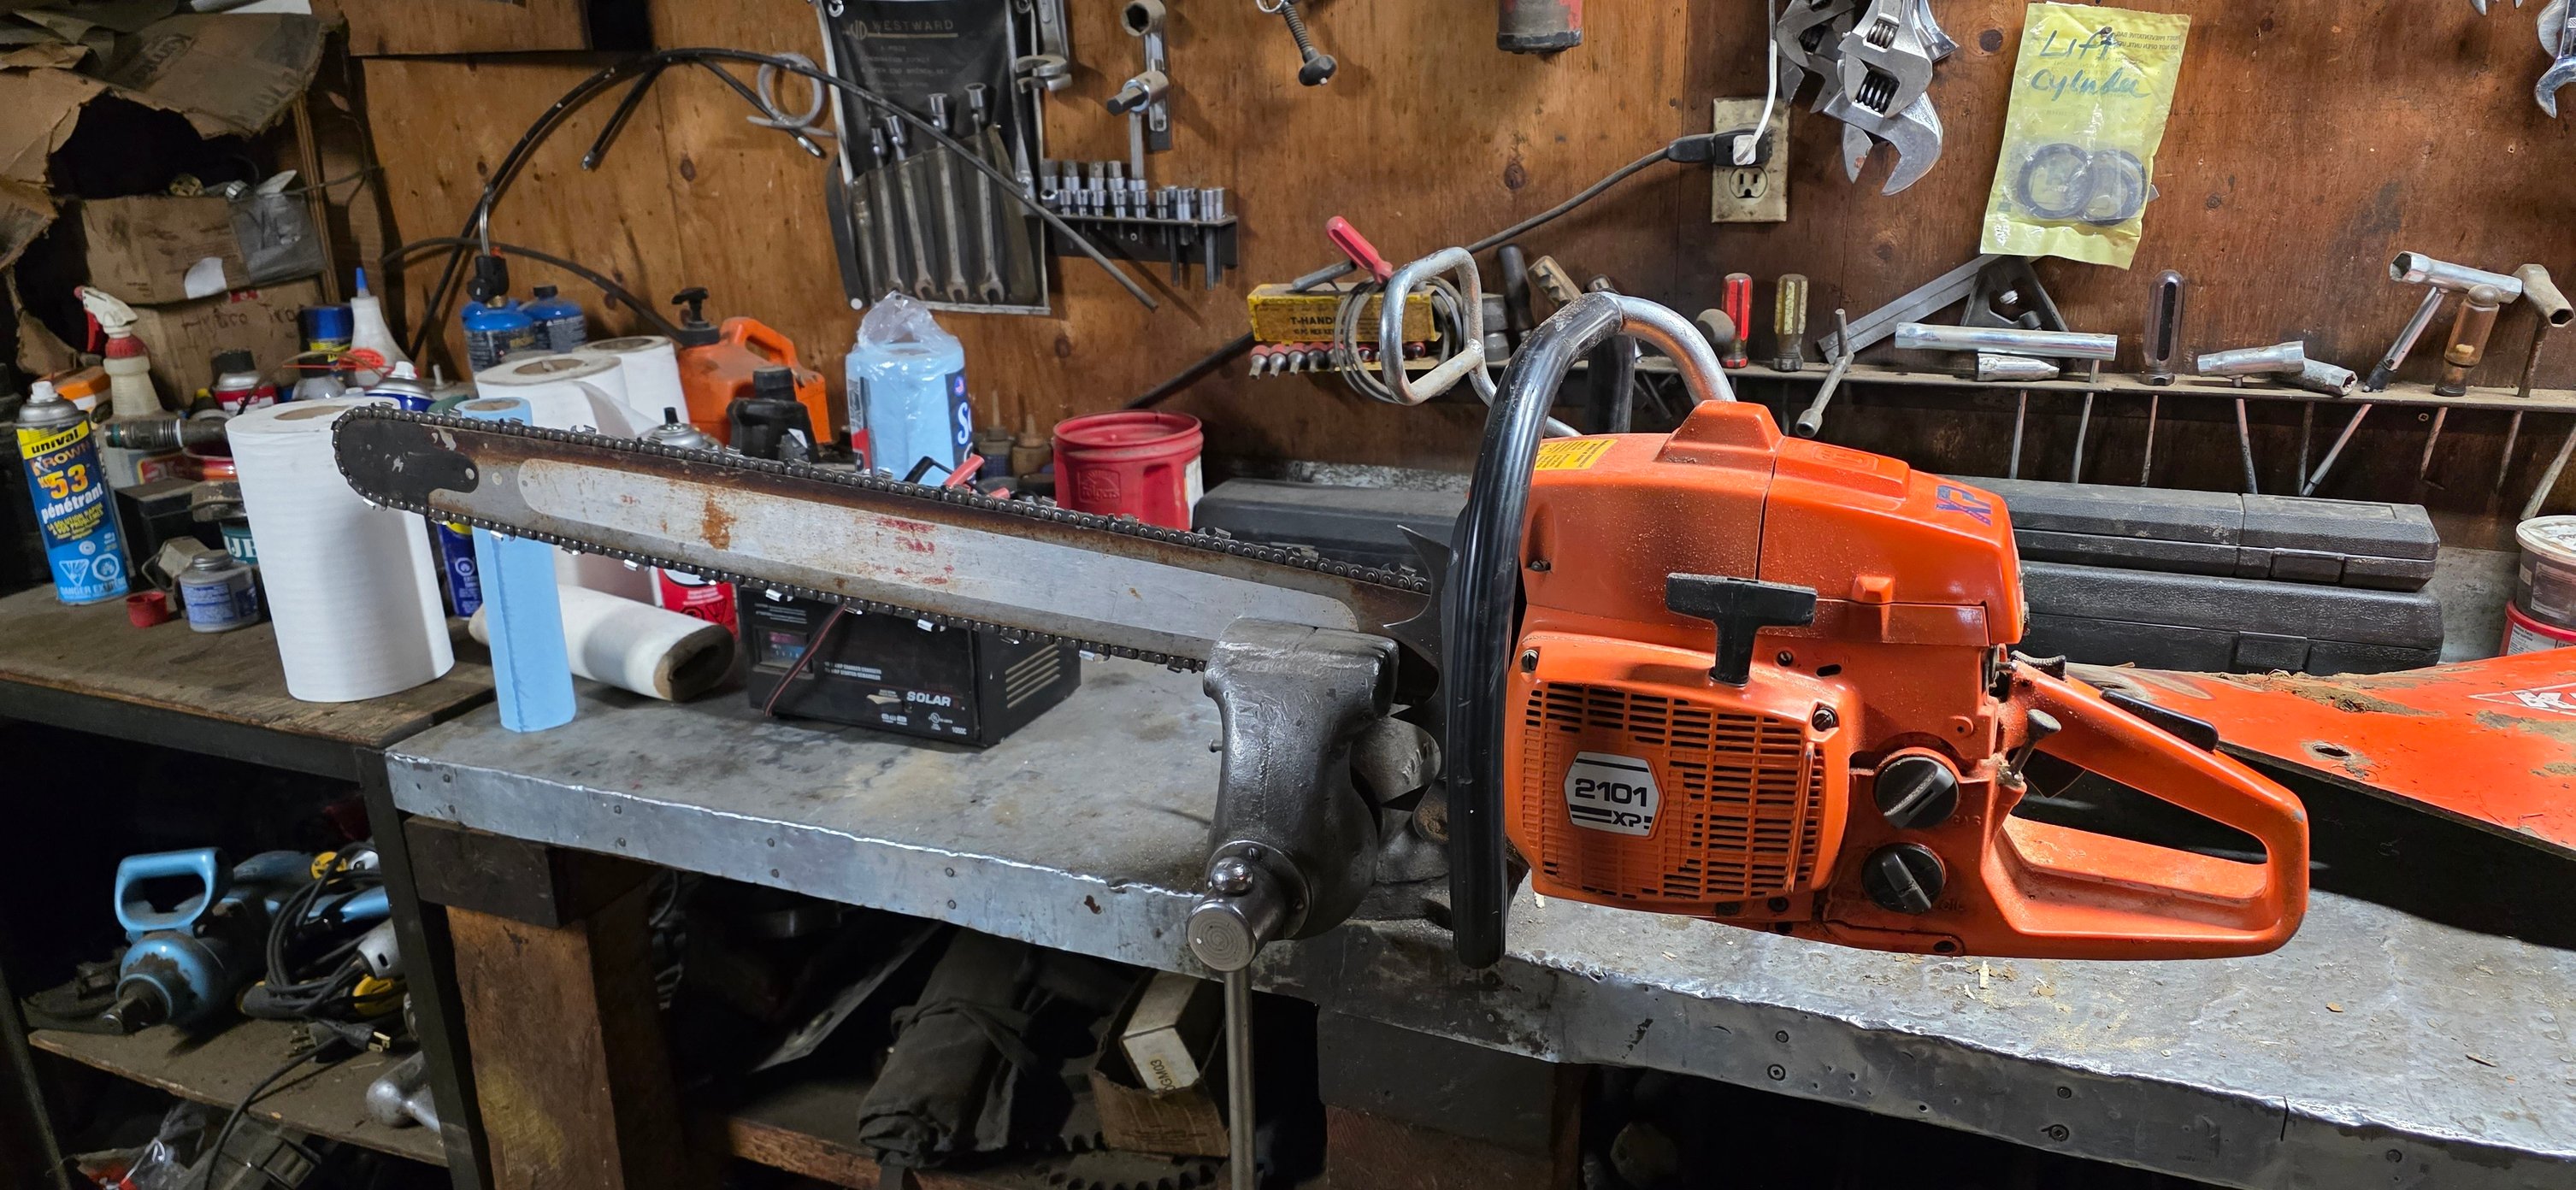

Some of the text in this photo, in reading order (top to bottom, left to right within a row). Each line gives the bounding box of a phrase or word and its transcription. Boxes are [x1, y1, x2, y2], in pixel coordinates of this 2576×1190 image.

[872, 19, 954, 32] WESTWARD
[41, 481, 103, 525] pénétrant
[1936, 484, 1992, 527] XP
[906, 691, 952, 707] SOLAR
[1575, 778, 1648, 807] 2101
[1612, 810, 1642, 827] XP
